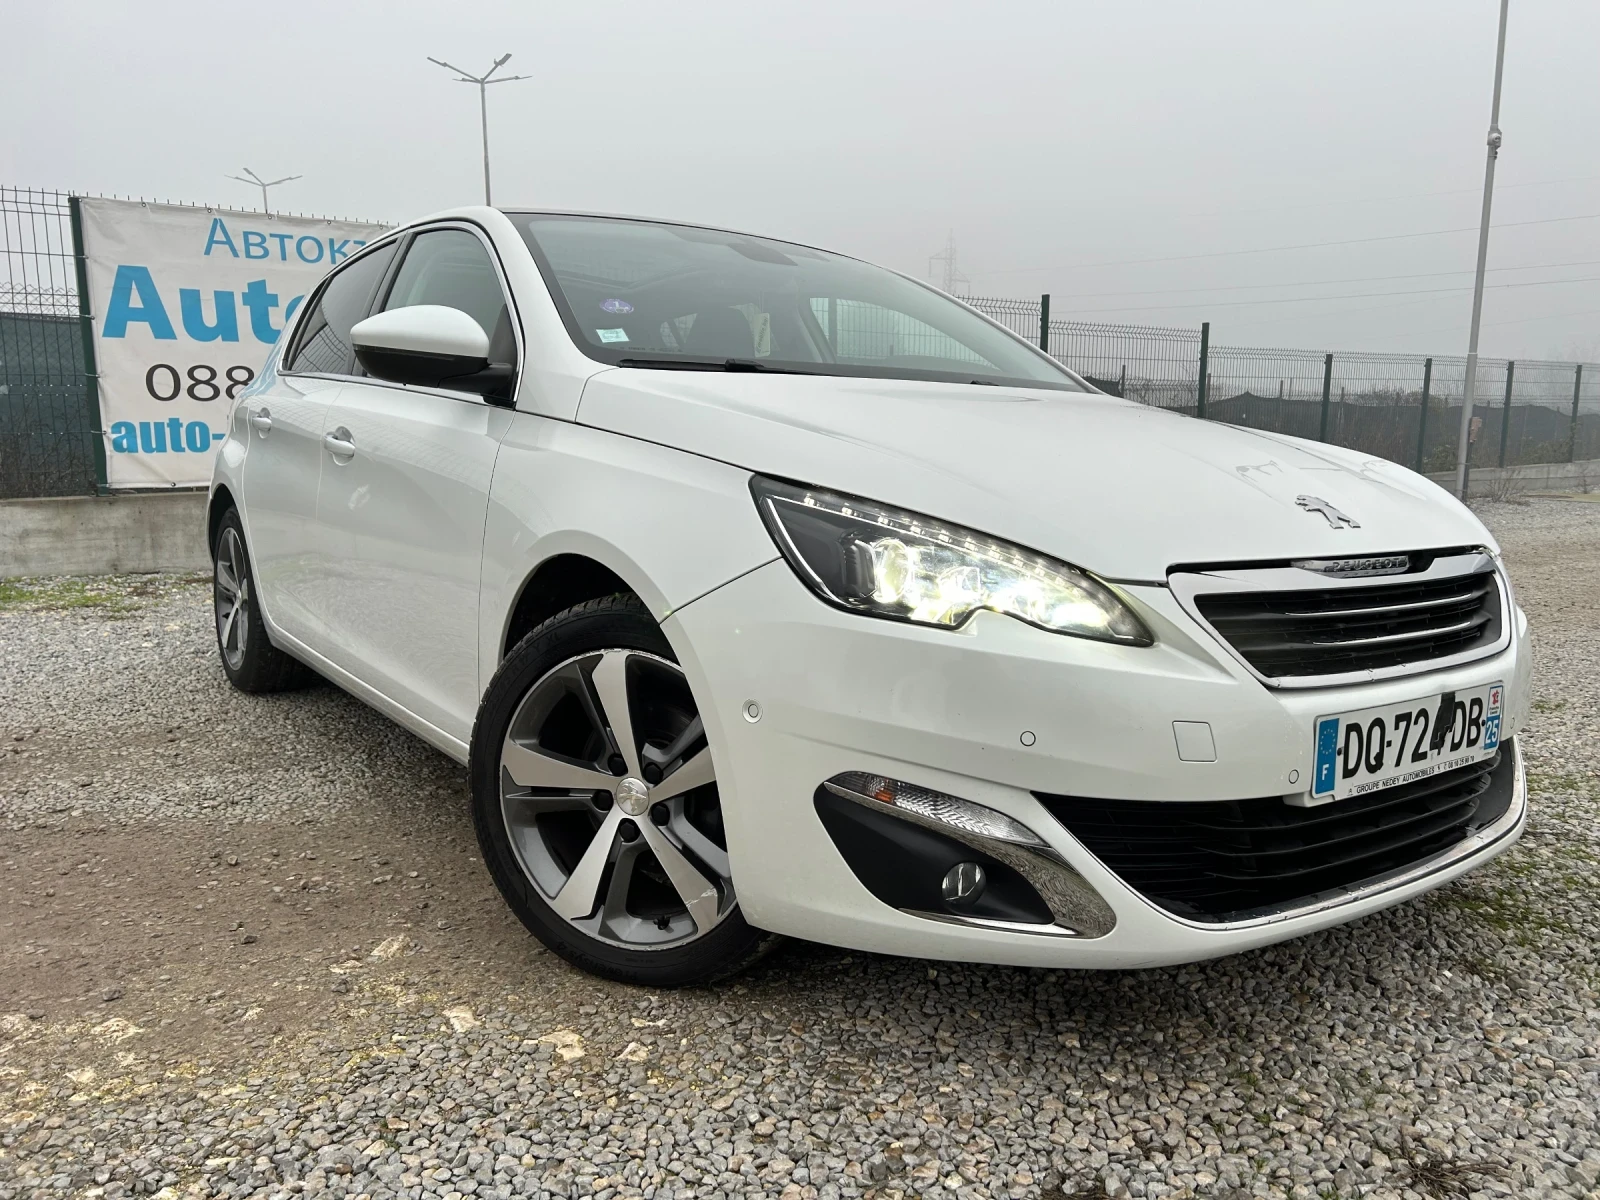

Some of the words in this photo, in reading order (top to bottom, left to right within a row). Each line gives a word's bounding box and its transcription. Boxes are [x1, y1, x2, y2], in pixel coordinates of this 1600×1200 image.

[102, 264, 305, 344] Aut
[1332, 557, 1399, 572] PEUGEOT
[1485, 720, 1499, 744] 25
[1321, 764, 1330, 781] F
[1356, 782, 1380, 794] GROUPE
[1382, 777, 1401, 788] NEDEY
[1402, 766, 1435, 783] AUTOMOBILES
